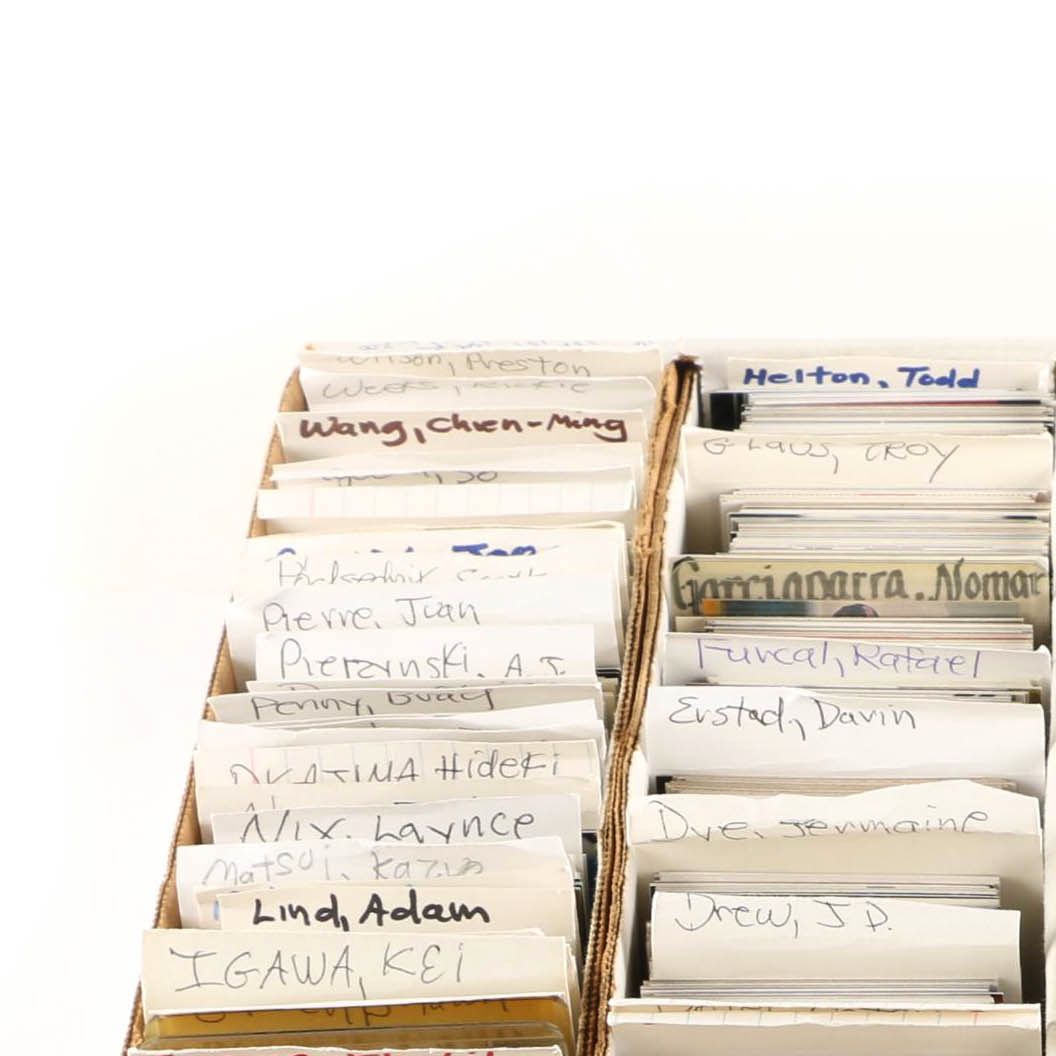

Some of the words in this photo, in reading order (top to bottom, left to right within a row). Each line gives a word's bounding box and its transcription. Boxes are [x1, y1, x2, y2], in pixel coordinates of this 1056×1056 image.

[465, 351, 593, 378] Preston
[742, 365, 889, 389] Helton,
[897, 366, 981, 389] Todd
[300, 416, 428, 447] Wang,
[926, 556, 1049, 601] Nomar
[394, 595, 481, 627] Juan
[696, 637, 845, 678] Furcal,
[845, 641, 983, 679] Rafael
[809, 698, 917, 730] Darin
[253, 893, 351, 932] Lind,
[358, 888, 491, 926] Adam
